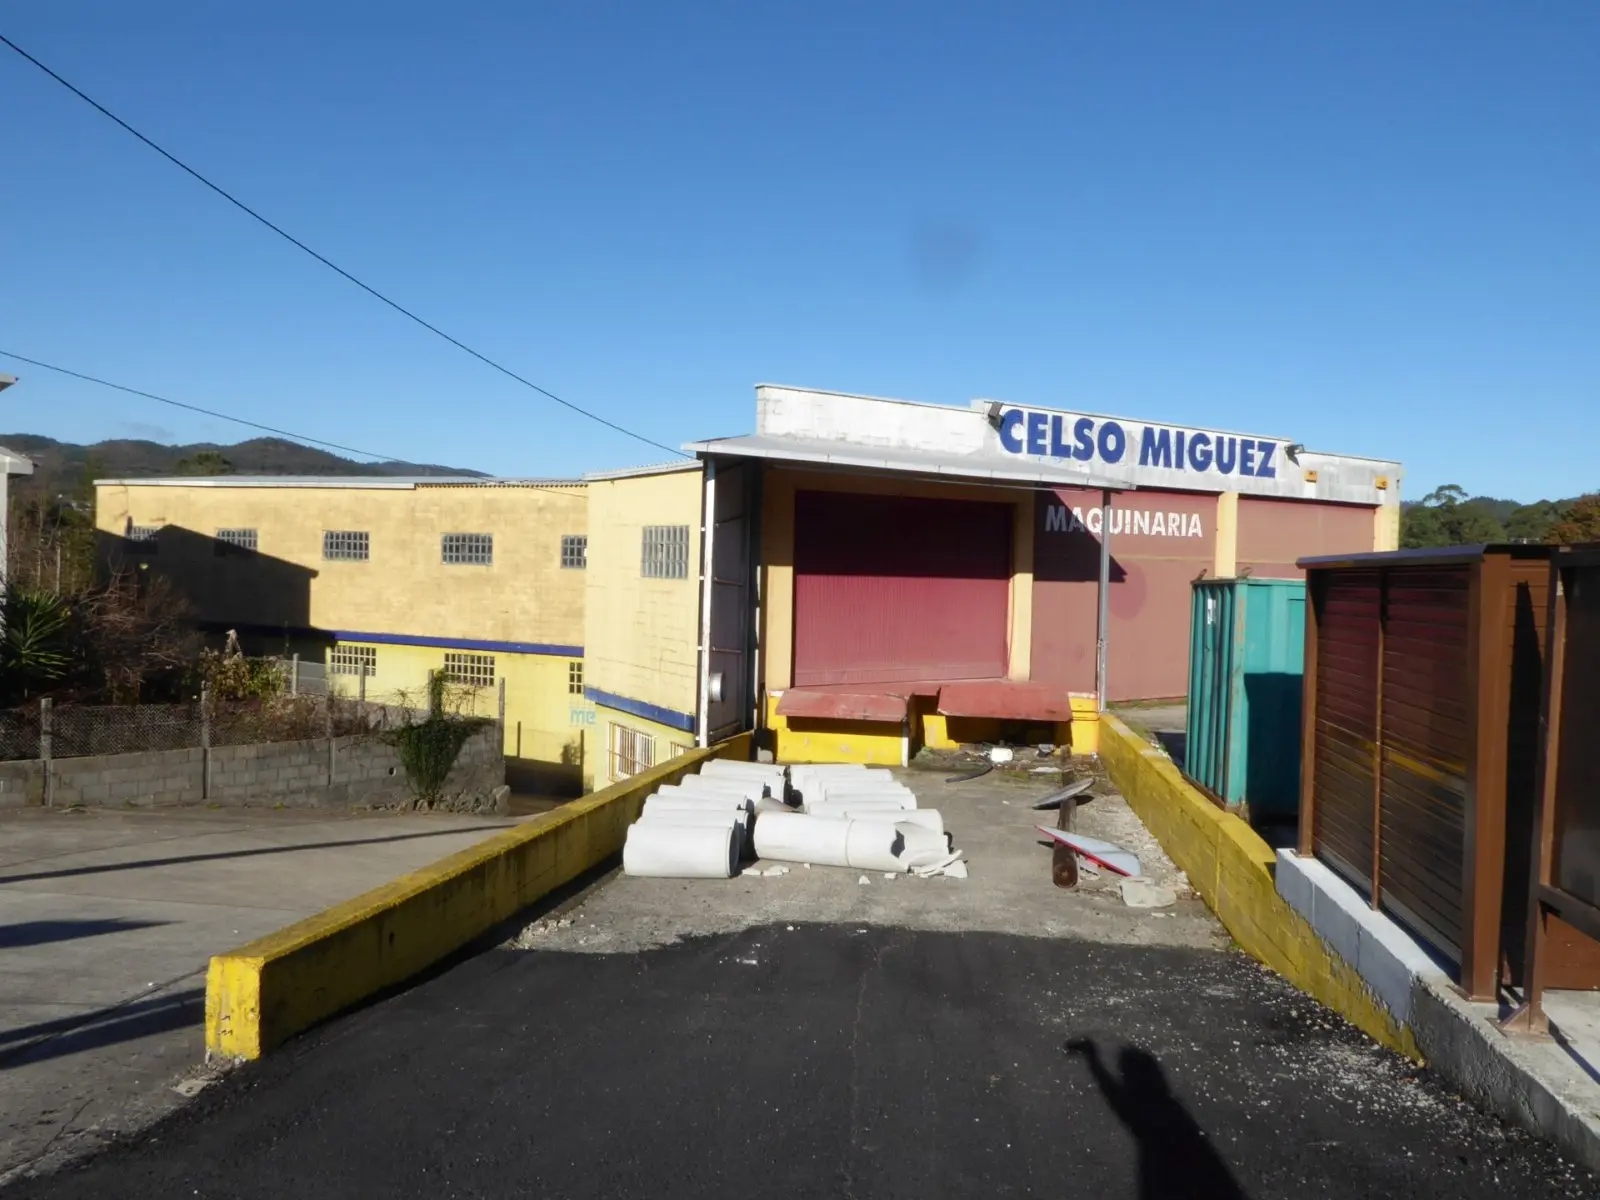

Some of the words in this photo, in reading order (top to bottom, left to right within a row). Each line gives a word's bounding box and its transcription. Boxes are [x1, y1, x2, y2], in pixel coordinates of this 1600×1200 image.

[1000, 409, 1125, 464] CELSO
[1138, 426, 1276, 478] MIGUEZ
[1045, 505, 1203, 538] MAQUINARIA
